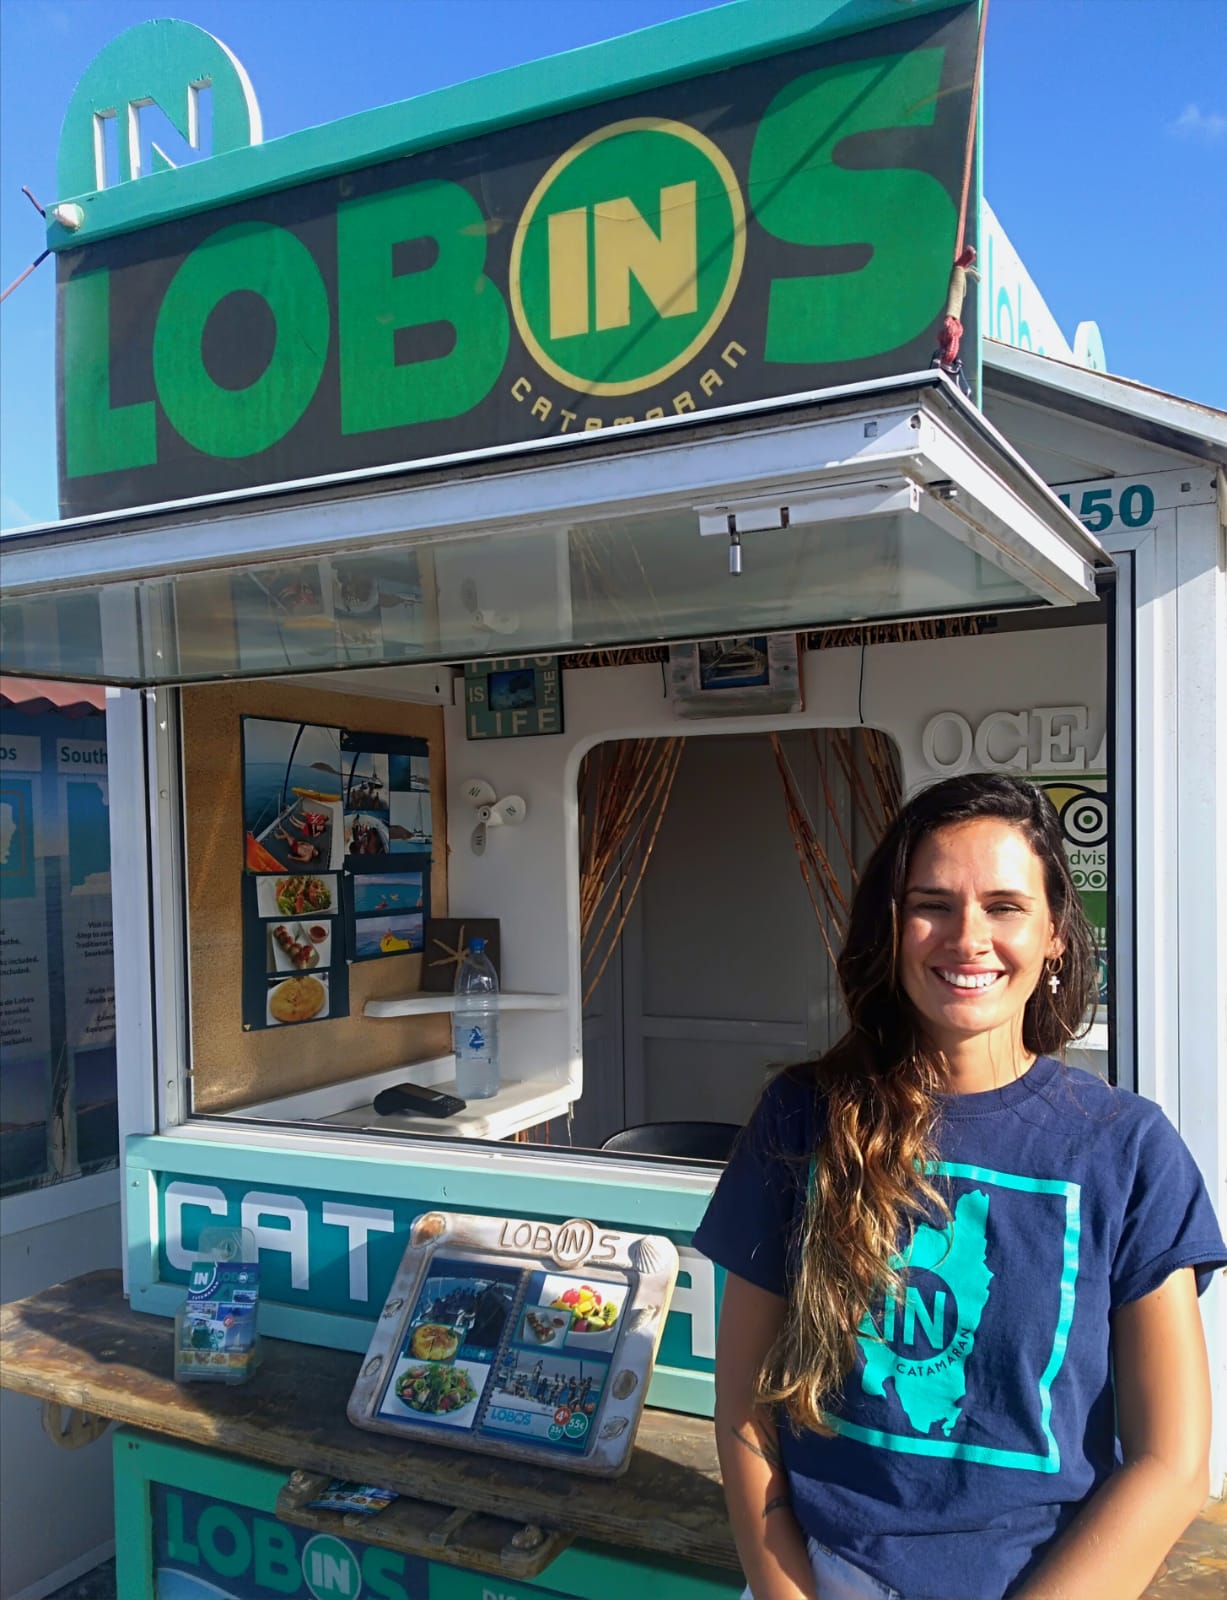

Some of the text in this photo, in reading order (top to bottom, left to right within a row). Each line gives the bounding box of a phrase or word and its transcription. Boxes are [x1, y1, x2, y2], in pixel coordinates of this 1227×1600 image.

[93, 77, 213, 191] IN
[469, 686, 484, 703] IS
[543, 671, 556, 705] THE
[471, 709, 555, 737] LIFE
[922, 706, 1107, 771] OCE
[194, 1272, 208, 1285] IN
[883, 1285, 946, 1350] IN
[896, 1327, 971, 1377] CATAMARAN
